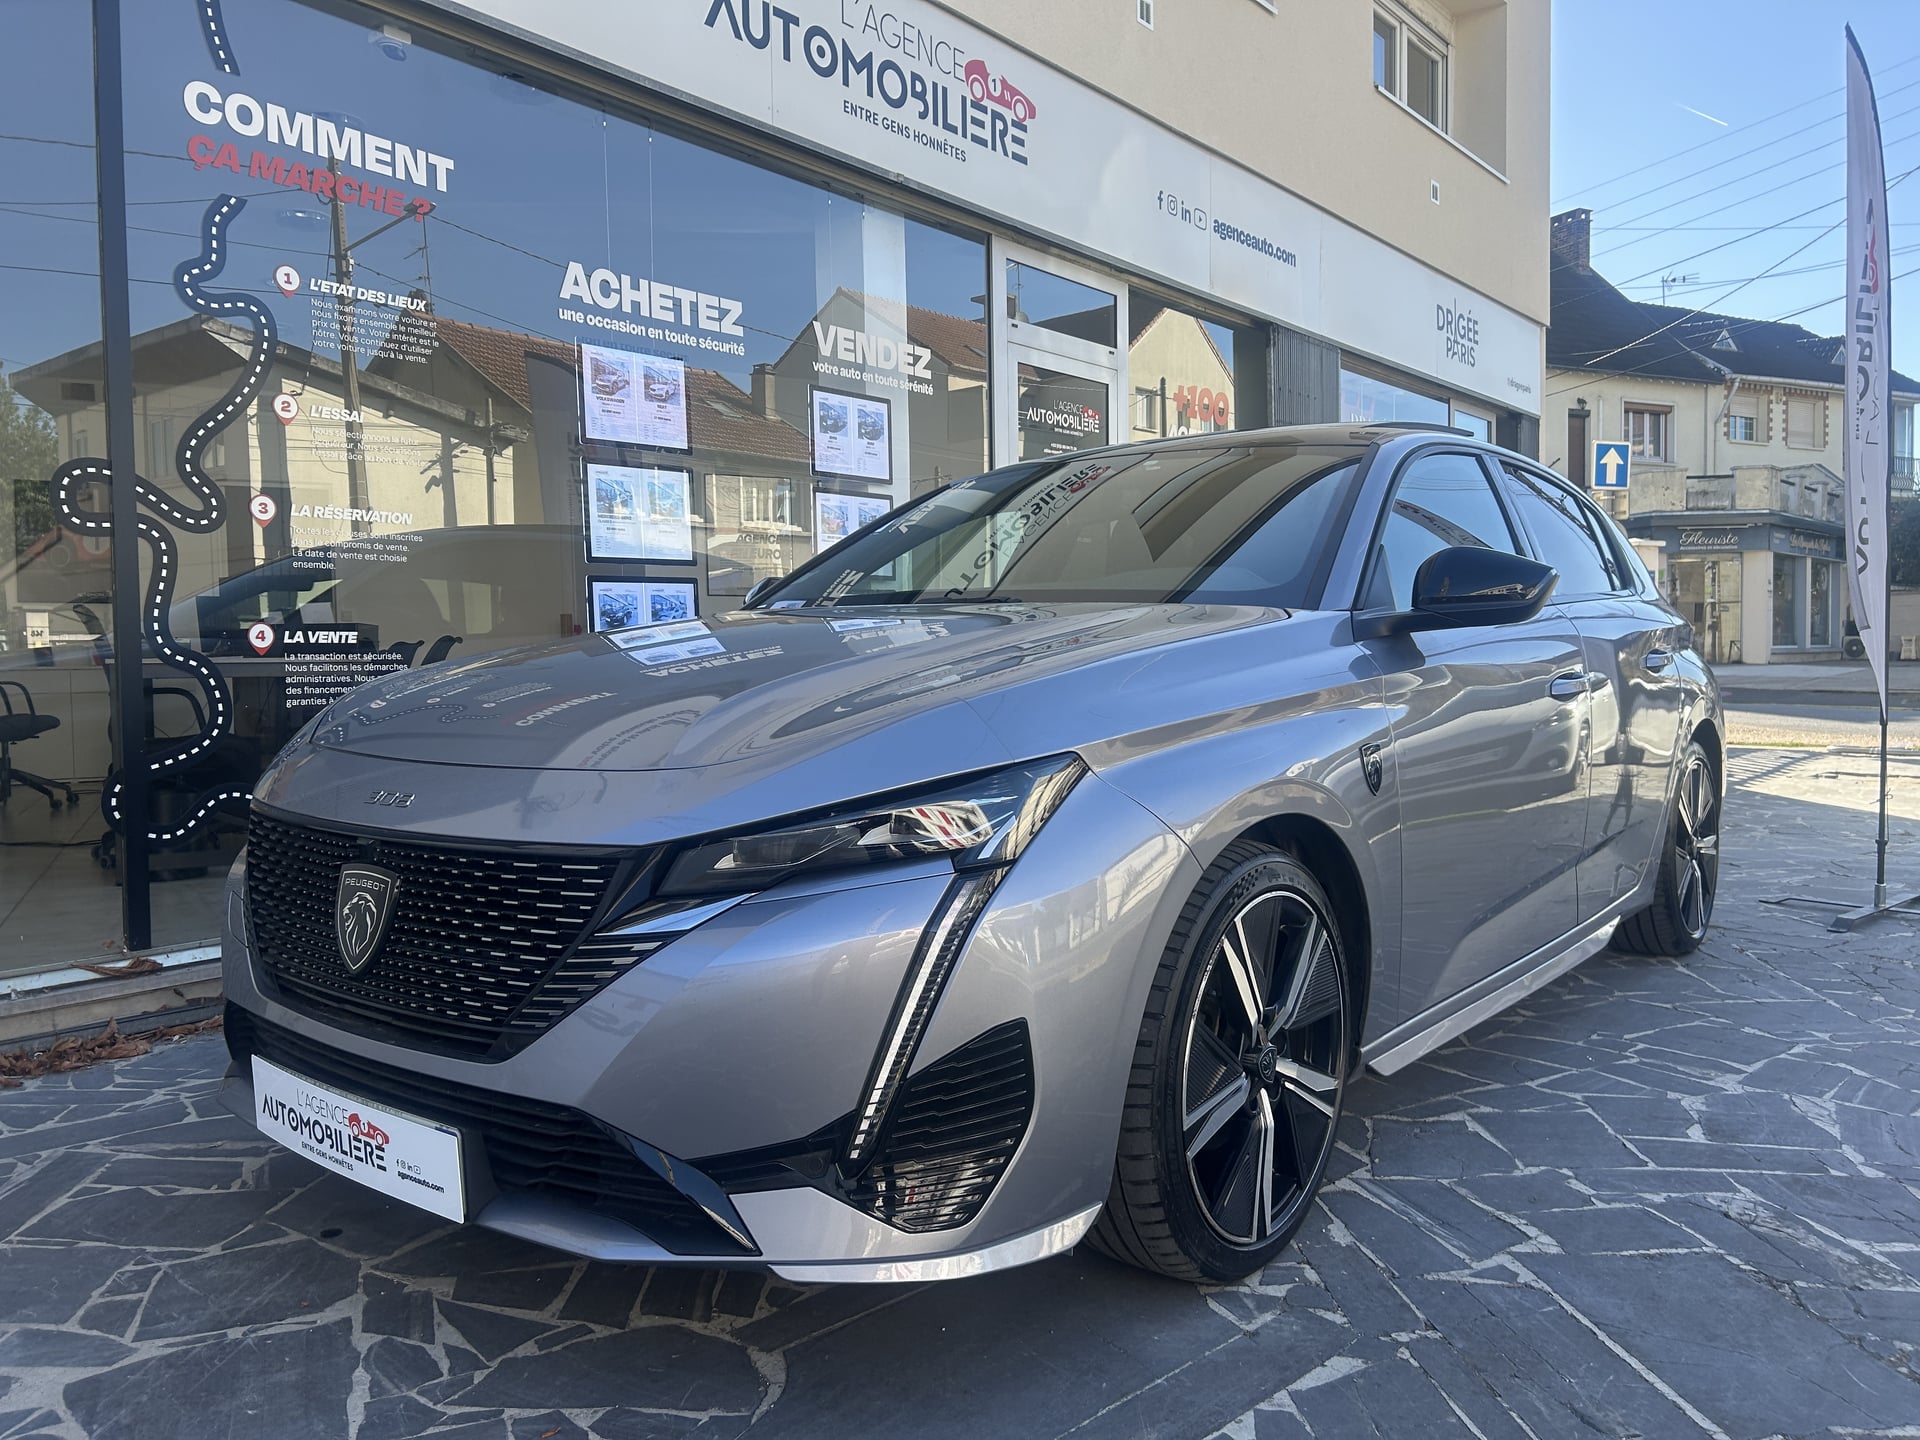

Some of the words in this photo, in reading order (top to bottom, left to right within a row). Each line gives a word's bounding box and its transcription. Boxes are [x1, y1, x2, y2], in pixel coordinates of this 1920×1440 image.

[183, 80, 454, 192] COMMENT
[843, 99, 879, 126] ENTRE
[882, 116, 910, 139] GENS
[913, 130, 966, 163] HONNÊTES
[187, 135, 241, 173] ÇA
[249, 152, 405, 217] MARCHE
[1213, 217, 1296, 268] agenceauto.com
[284, 273, 292, 285] 1
[309, 278, 355, 298] L'ETAT
[357, 287, 386, 304] DES
[388, 294, 427, 312] LIEUX
[559, 261, 744, 337] ACHETEZ
[311, 299, 333, 309] Nous
[335, 303, 377, 318] examinons
[379, 312, 399, 322] votre
[401, 316, 428, 327] voiture
[429, 321, 437, 329] et
[311, 309, 332, 319] nous
[334, 312, 358, 324] fixons
[360, 316, 397, 331] ensemble
[399, 324, 406, 332] le
[407, 326, 437, 338] meilleur
[312, 319, 328, 330] prix
[330, 321, 340, 330] de
[342, 325, 367, 336] vente.
[369, 328, 391, 340] Votre
[392, 332, 417, 345] intérêt
[419, 337, 431, 346] est
[432, 339, 439, 348] le
[558, 307, 584, 324] une
[586, 312, 646, 339] occasion
[648, 325, 663, 340] en
[665, 328, 697, 347] toute
[699, 333, 745, 356] sécurité
[312, 328, 337, 339] nôtre.
[339, 333, 359, 344] Vous
[360, 337, 399, 351] continuez
[400, 343, 433, 356] d'utiliser
[813, 320, 932, 380] VENDEZ
[313, 340, 335, 349] votre
[337, 342, 365, 354] voiture
[366, 348, 395, 361] jusqu'à
[396, 351, 403, 360] la
[405, 354, 428, 364] vente.
[1446, 336, 1475, 368] PARIS
[813, 360, 837, 376] votre
[839, 364, 861, 380] auto
[863, 371, 873, 382] en
[874, 371, 899, 388] toute
[900, 374, 933, 396] sérénité
[281, 401, 291, 413] 2
[310, 405, 364, 423] L'ESSAI
[1053, 400, 1083, 414] L'AGENCE
[1173, 385, 1229, 426] +100
[312, 426, 334, 437] Nous
[357, 442, 378, 452] Nous
[259, 502, 268, 515] 3
[291, 504, 312, 518] LA
[314, 504, 413, 525] RÉSERVATION
[292, 526, 320, 536] Toutes
[389, 532, 423, 542] inscrites
[1679, 531, 1739, 545] Fleuriste
[292, 548, 303, 557] La
[303, 549, 324, 558] date
[327, 550, 337, 559] de
[339, 552, 363, 561] vente
[364, 552, 377, 562] est
[379, 553, 407, 563] choisie
[326, 540, 372, 551] compromis
[373, 542, 383, 551] de
[386, 543, 410, 552] vente.
[292, 561, 336, 571] ensemble.
[255, 630, 266, 642] 4
[284, 631, 304, 644] LA
[307, 631, 358, 644] VENTE
[284, 652, 295, 661] La
[297, 652, 346, 661] transaction
[348, 653, 361, 661] est
[363, 651, 404, 661] sécurisée.
[285, 663, 308, 672] Nous
[309, 663, 348, 672] facilitons
[350, 663, 362, 672] les
[364, 662, 408, 672] démarches
[285, 674, 353, 684] administratives.
[354, 674, 375, 683] Nous
[286, 686, 302, 695] des
[286, 697, 327, 708] garanties
[345, 877, 386, 892] PEUGEOT
[296, 1088, 349, 1127] L'AGENCE
[301, 1141, 315, 1154] ENTRE
[315, 1147, 328, 1160] GENS
[328, 1152, 354, 1172] HONNÊTES
[398, 1170, 445, 1194] agenceauto.com
